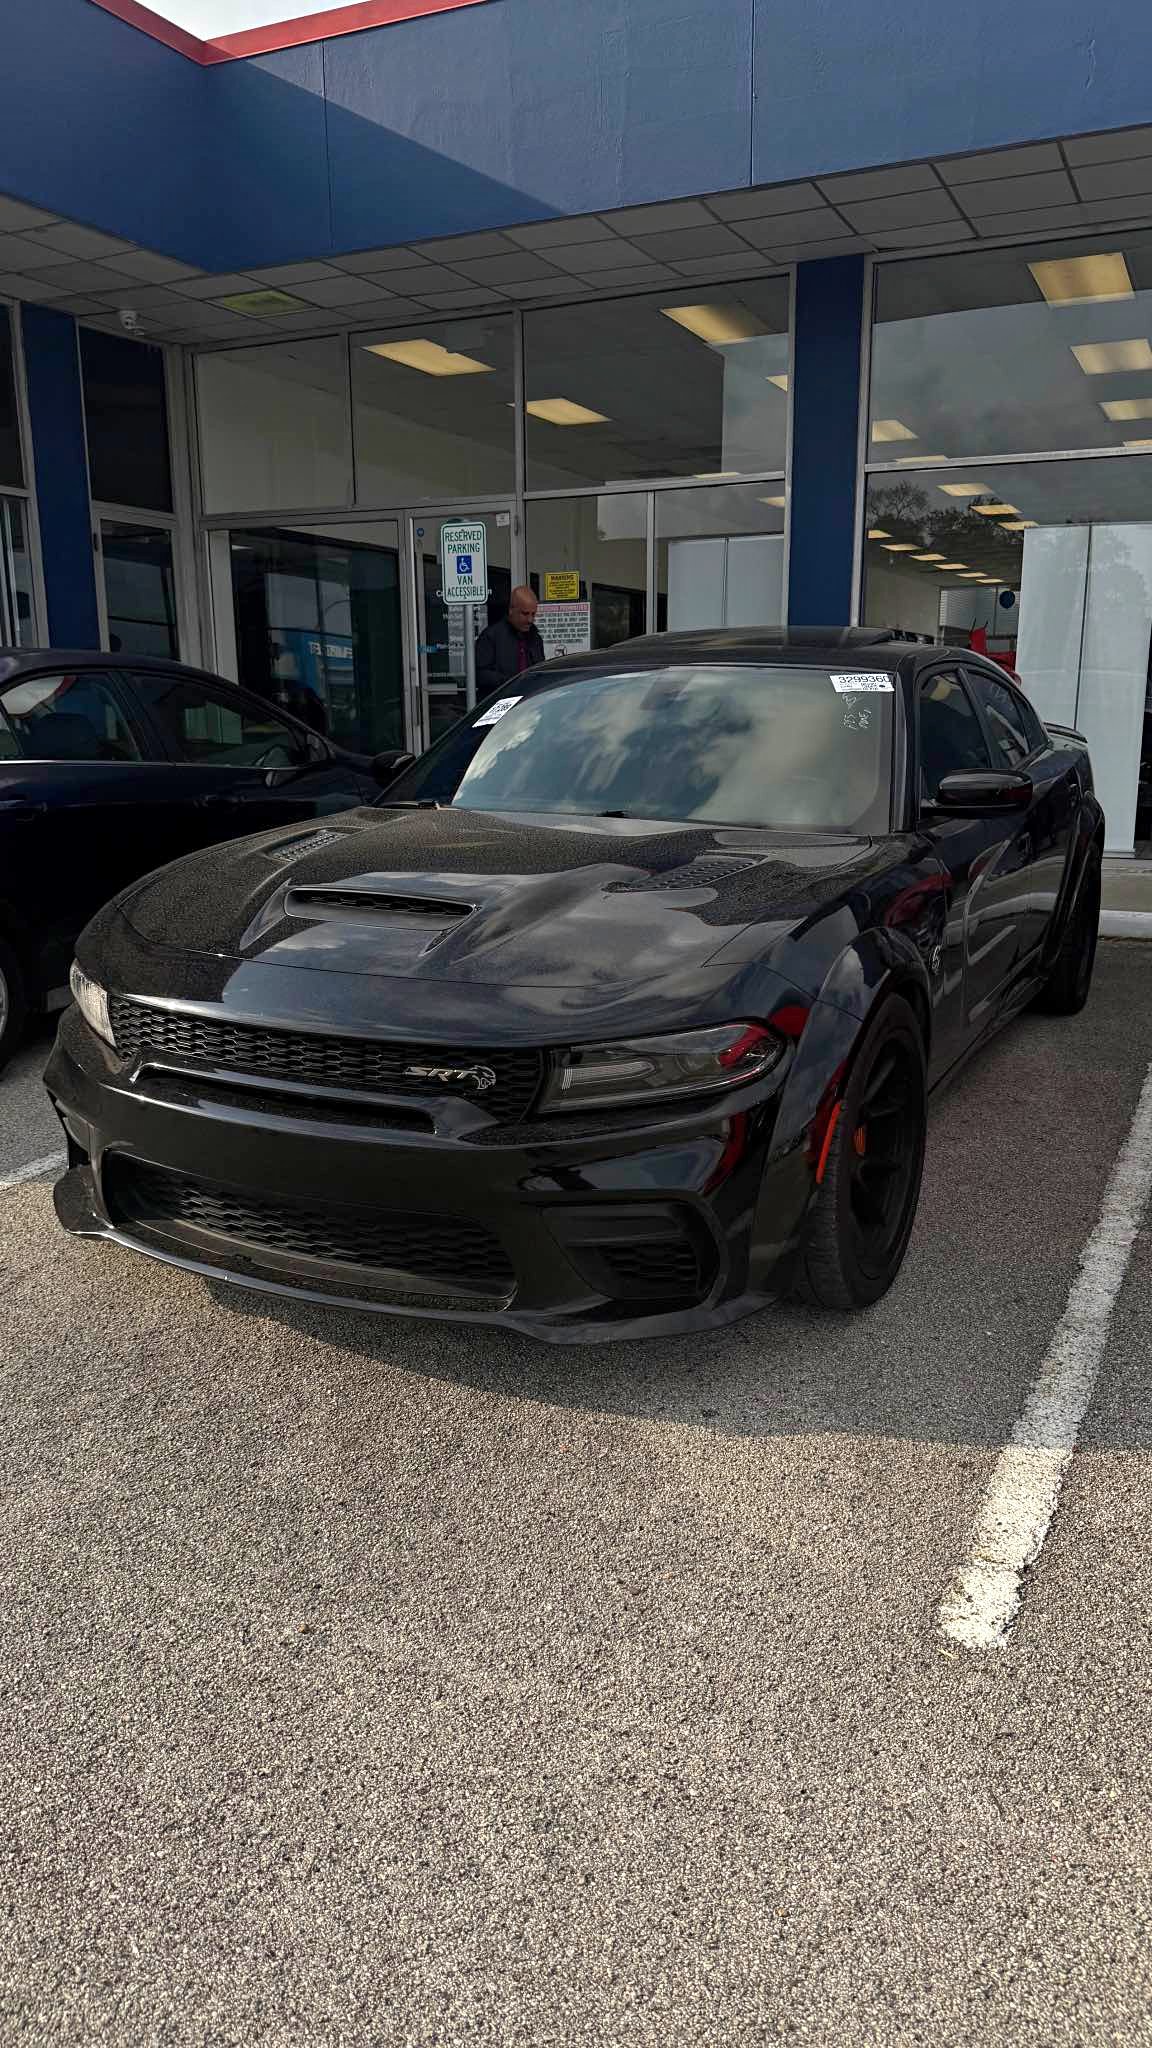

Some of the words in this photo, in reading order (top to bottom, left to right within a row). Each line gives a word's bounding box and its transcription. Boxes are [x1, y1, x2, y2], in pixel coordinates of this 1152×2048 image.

[445, 530, 482, 542] RESERVED
[447, 543, 481, 554] PARKING
[457, 575, 473, 586] VAN
[447, 586, 484, 597] ACCESSIBLE
[403, 1066, 477, 1081] SRT
